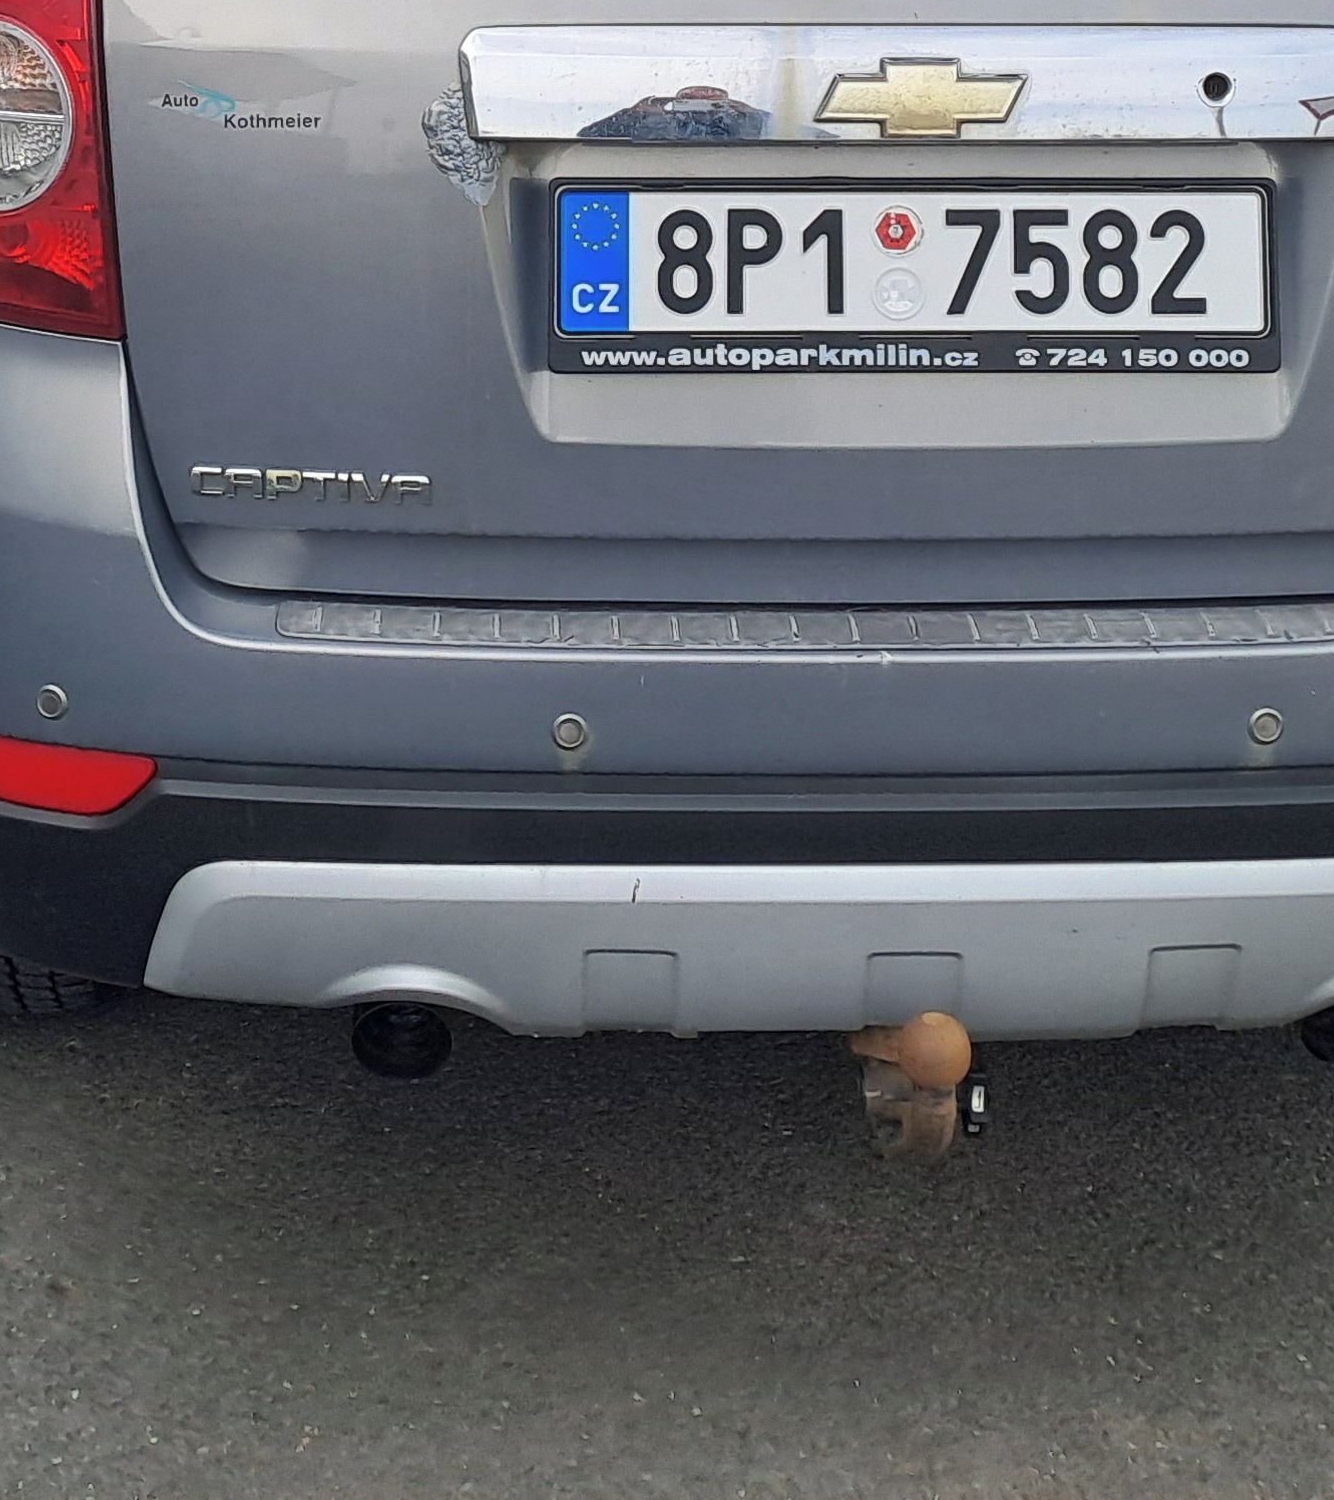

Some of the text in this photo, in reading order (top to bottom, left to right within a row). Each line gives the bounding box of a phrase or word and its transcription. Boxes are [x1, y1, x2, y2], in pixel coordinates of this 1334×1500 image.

[161, 93, 199, 108] Auto
[223, 113, 322, 129] Kothmeier
[657, 208, 1208, 315] 8P1 7582
[571, 283, 620, 313] CZ
[581, 343, 1251, 371] www.autoparkmilin.cz 724 150 000
[190, 465, 433, 506] CAPTIVA
